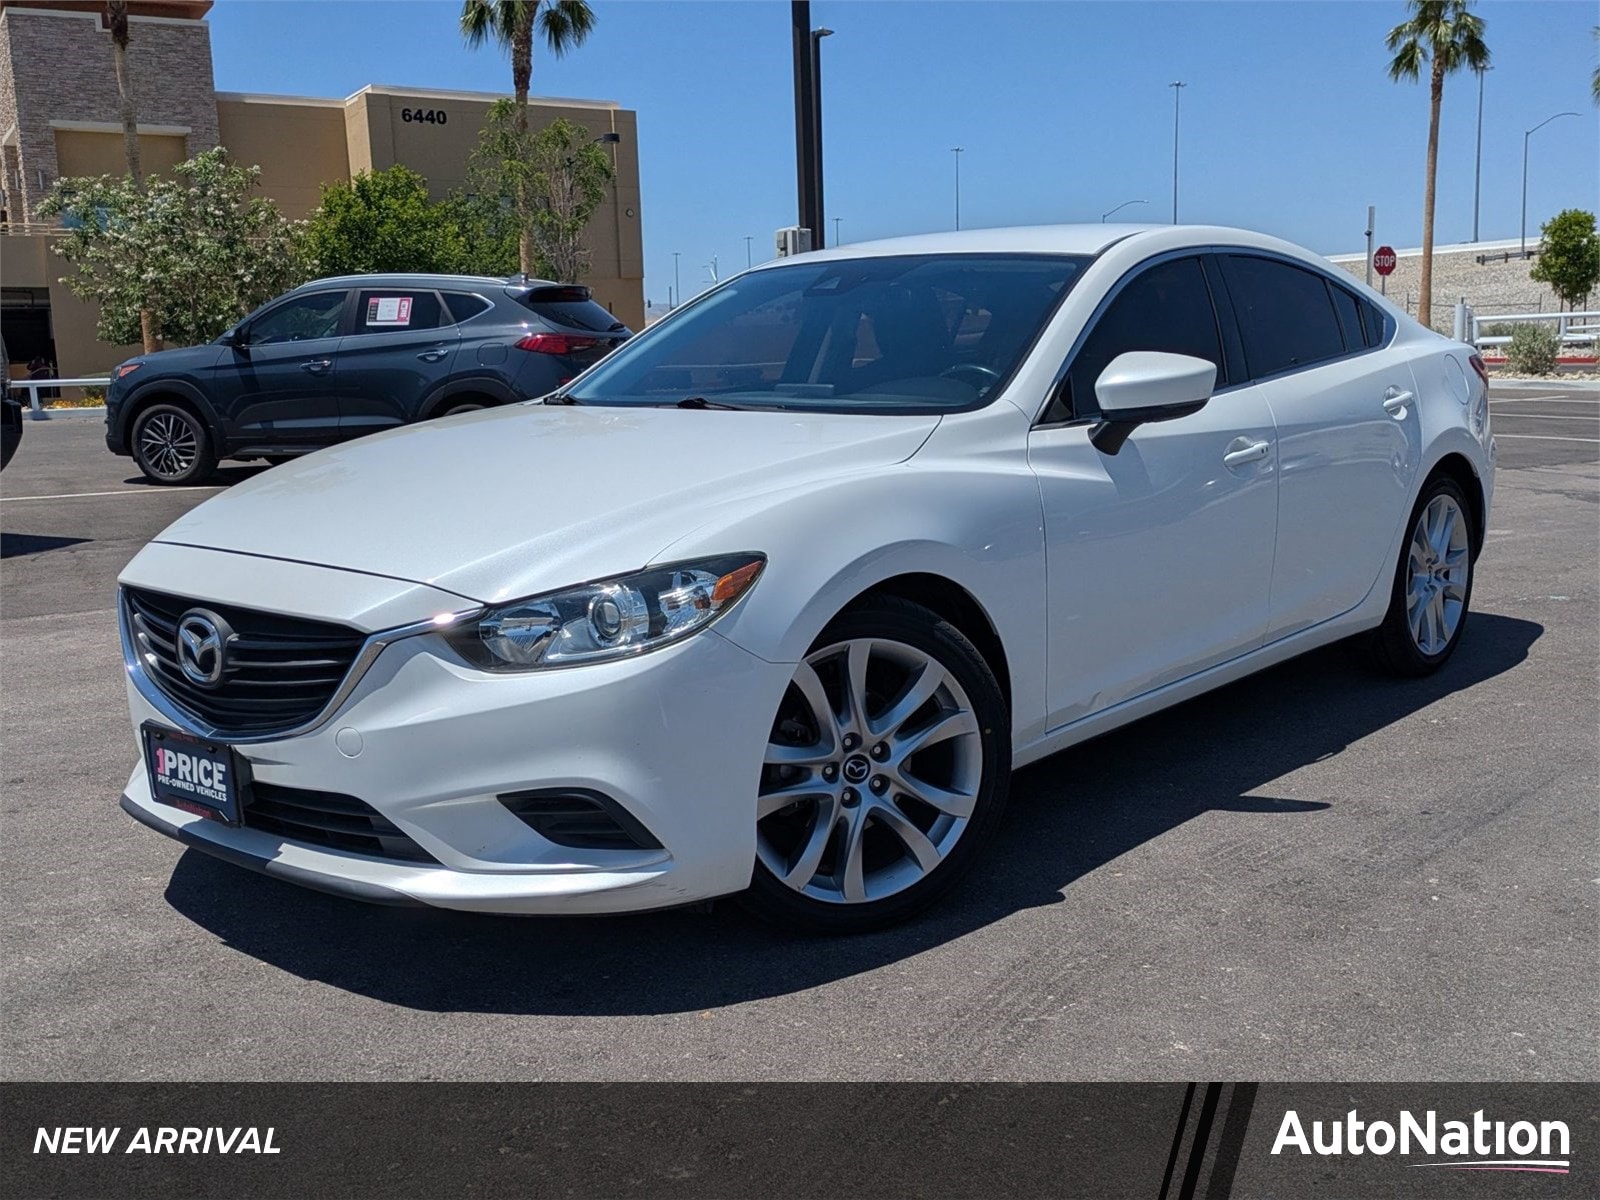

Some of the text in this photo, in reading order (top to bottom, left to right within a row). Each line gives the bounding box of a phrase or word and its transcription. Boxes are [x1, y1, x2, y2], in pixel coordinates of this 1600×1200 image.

[401, 108, 447, 125] 6440
[1375, 255, 1395, 267] STOP
[156, 747, 227, 792] 1PRICE
[157, 774, 227, 802] PRE-OWNED VEHICLES
